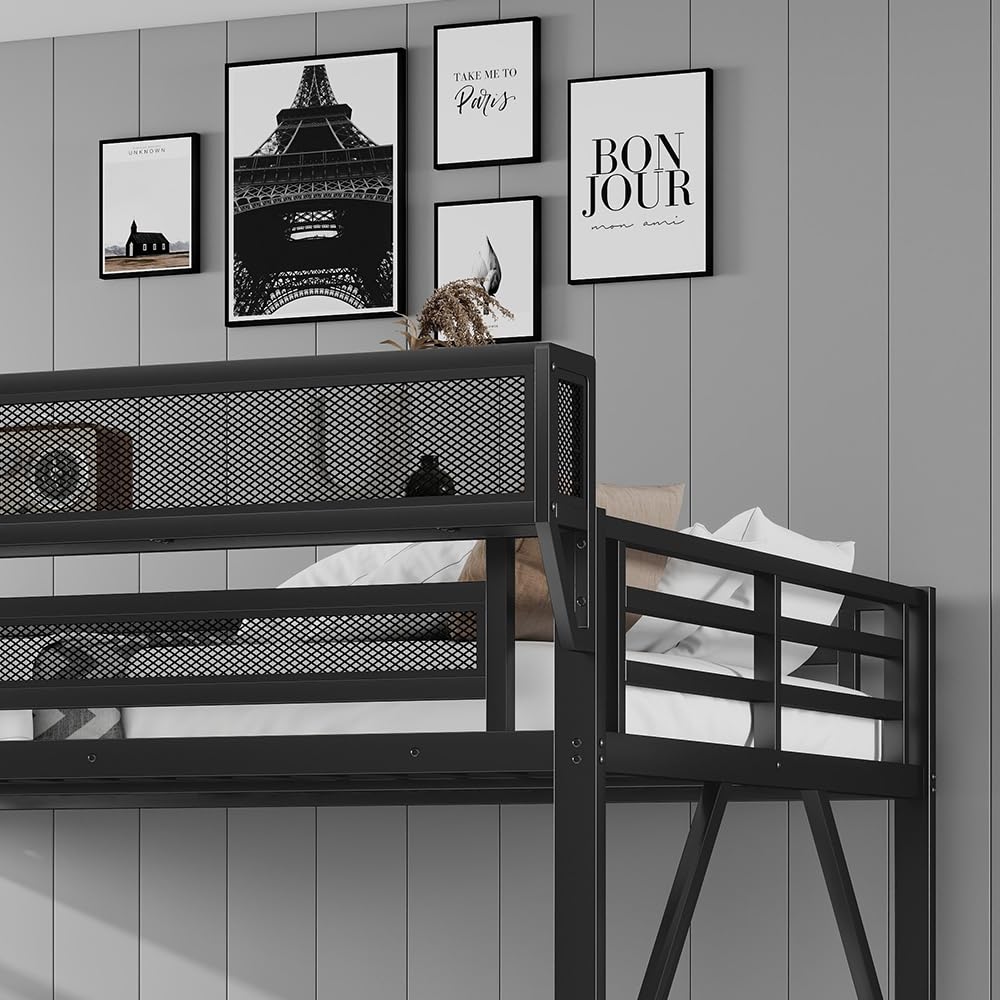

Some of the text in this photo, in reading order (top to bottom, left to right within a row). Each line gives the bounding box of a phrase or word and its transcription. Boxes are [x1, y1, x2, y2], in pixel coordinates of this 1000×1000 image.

[453, 68, 517, 82] TAKE ME TO
[454, 84, 516, 117] Paris
[128, 147, 166, 156] UNKNOWN
[591, 132, 685, 176] BON
[581, 169, 695, 218] JOUR
[643, 215, 685, 227] ami
